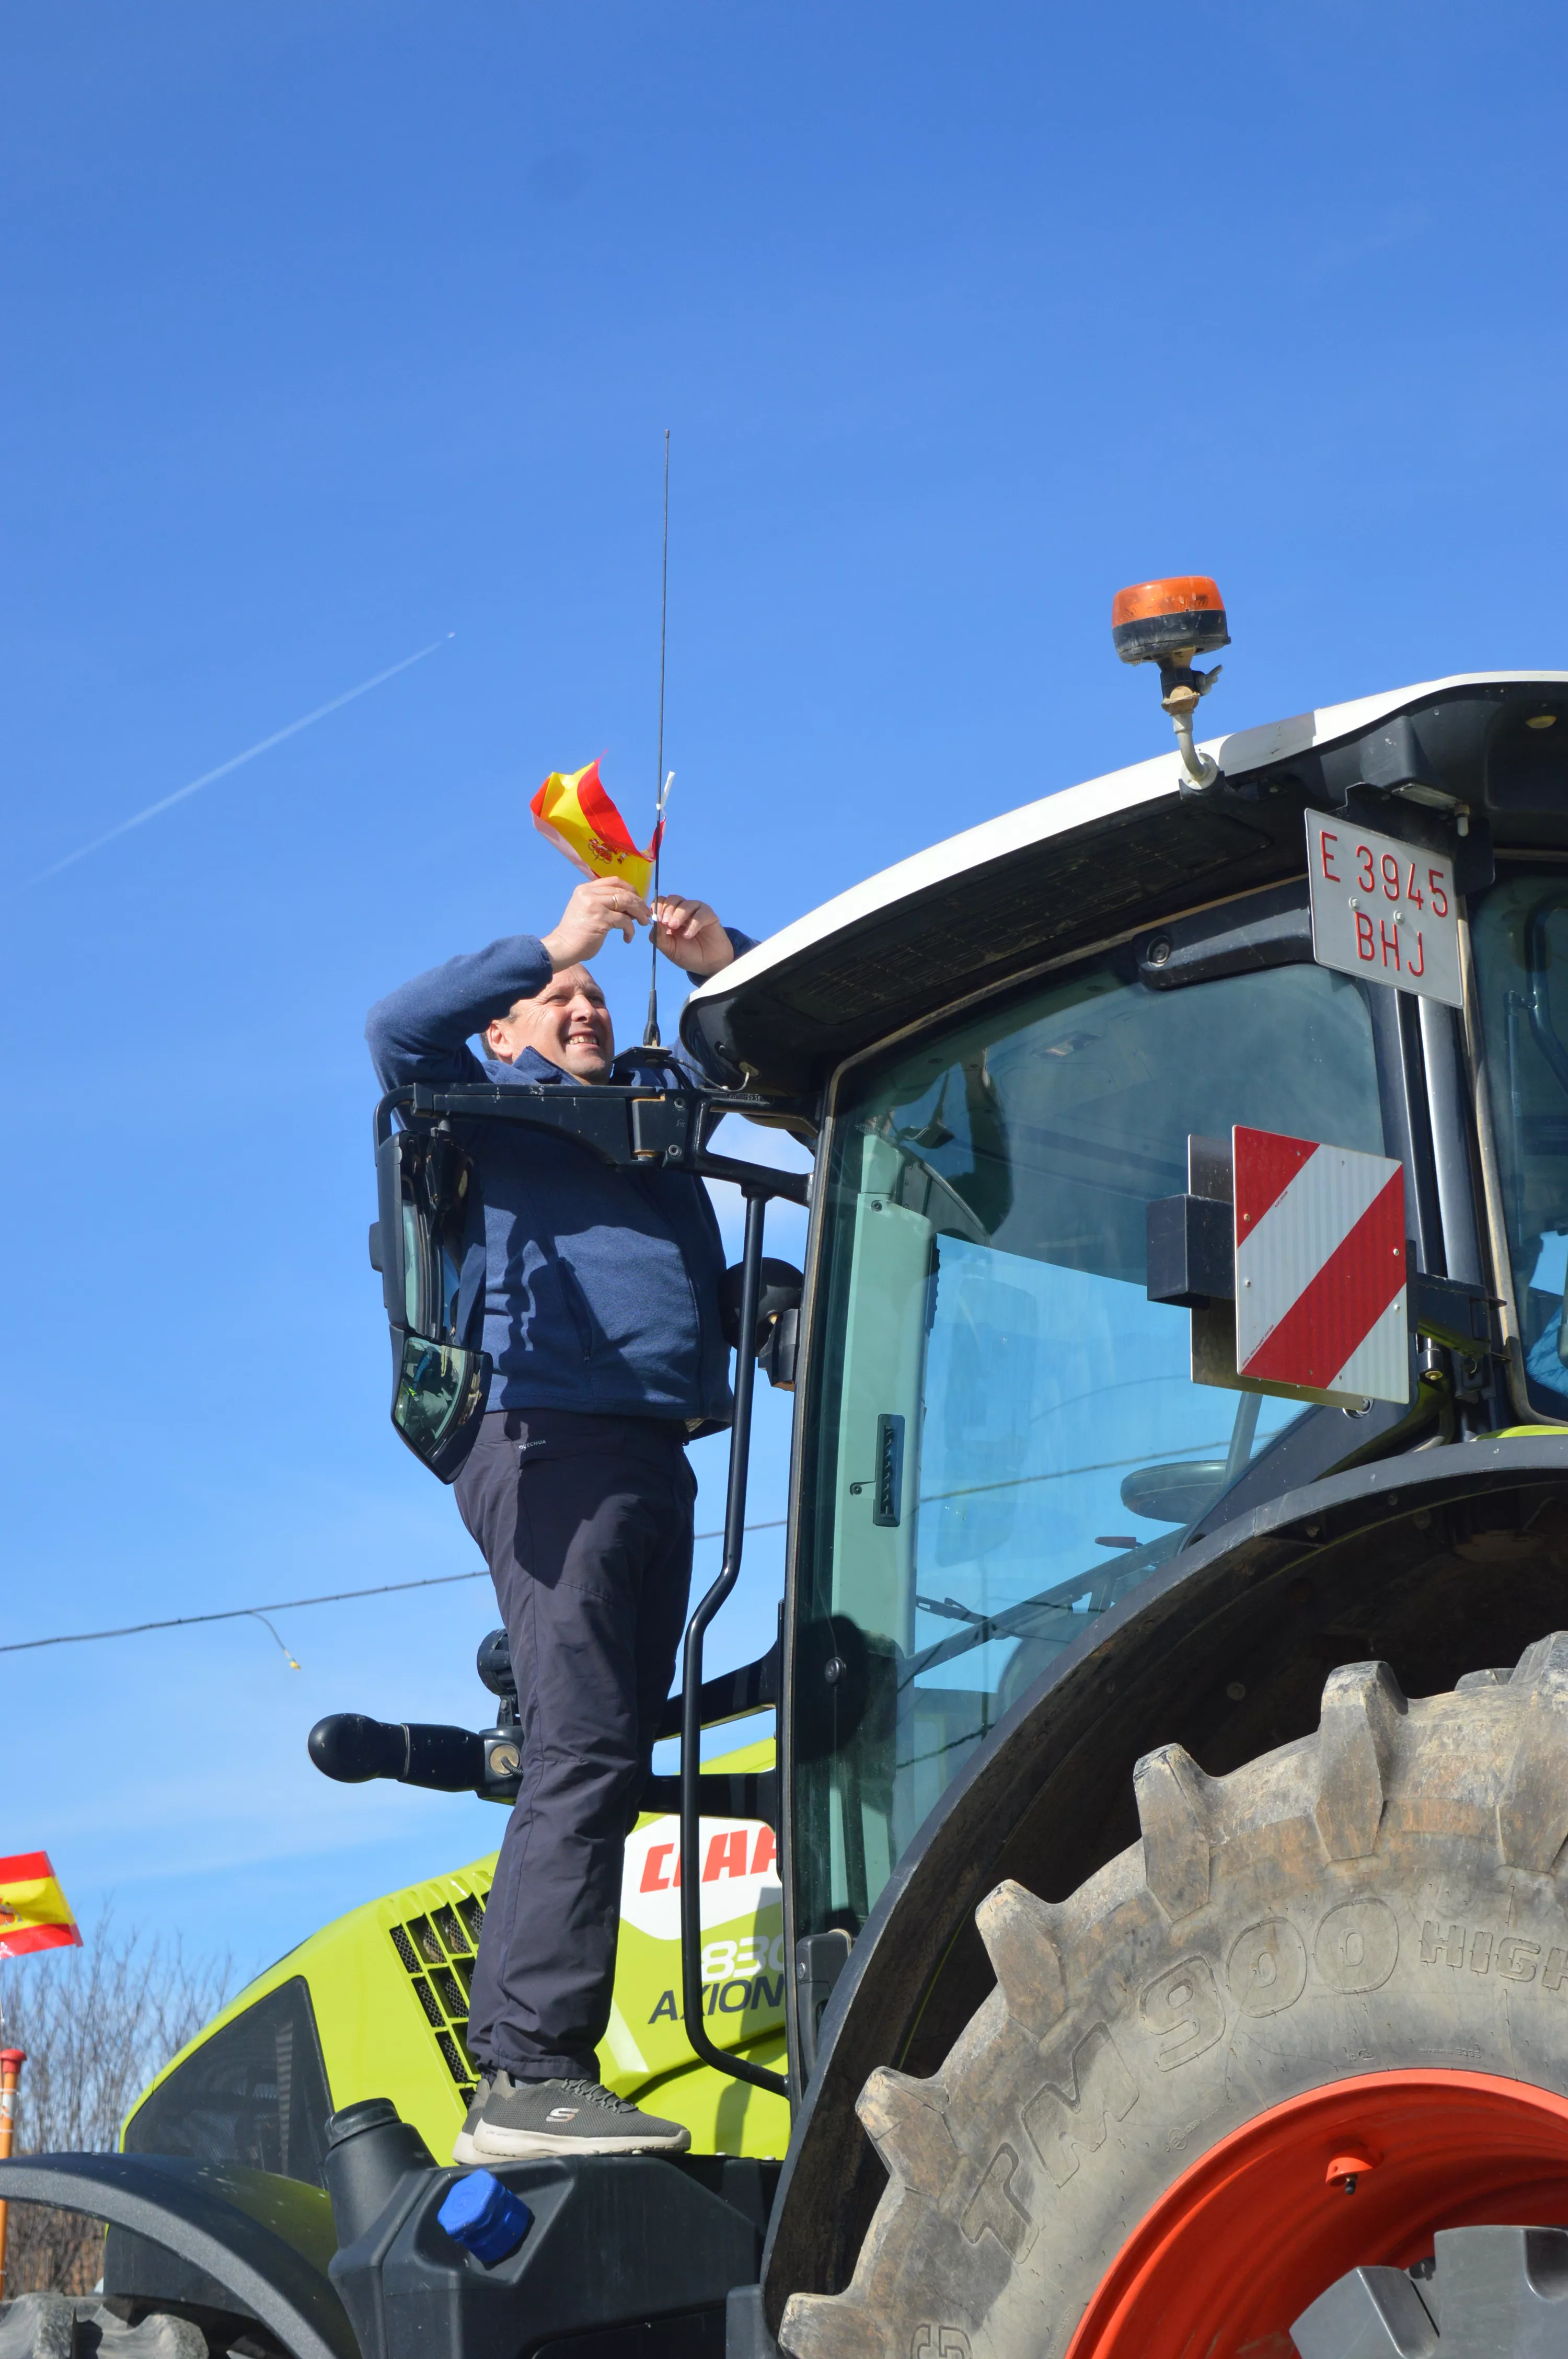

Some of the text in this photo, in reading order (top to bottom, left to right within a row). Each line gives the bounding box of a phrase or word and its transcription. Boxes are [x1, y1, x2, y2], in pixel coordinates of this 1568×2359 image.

[1320, 831, 1448, 918] E 3945
[1355, 912, 1424, 977] BHJ
[518, 1440, 546, 1449] QUECHUA
[648, 1973, 785, 2024] AION
